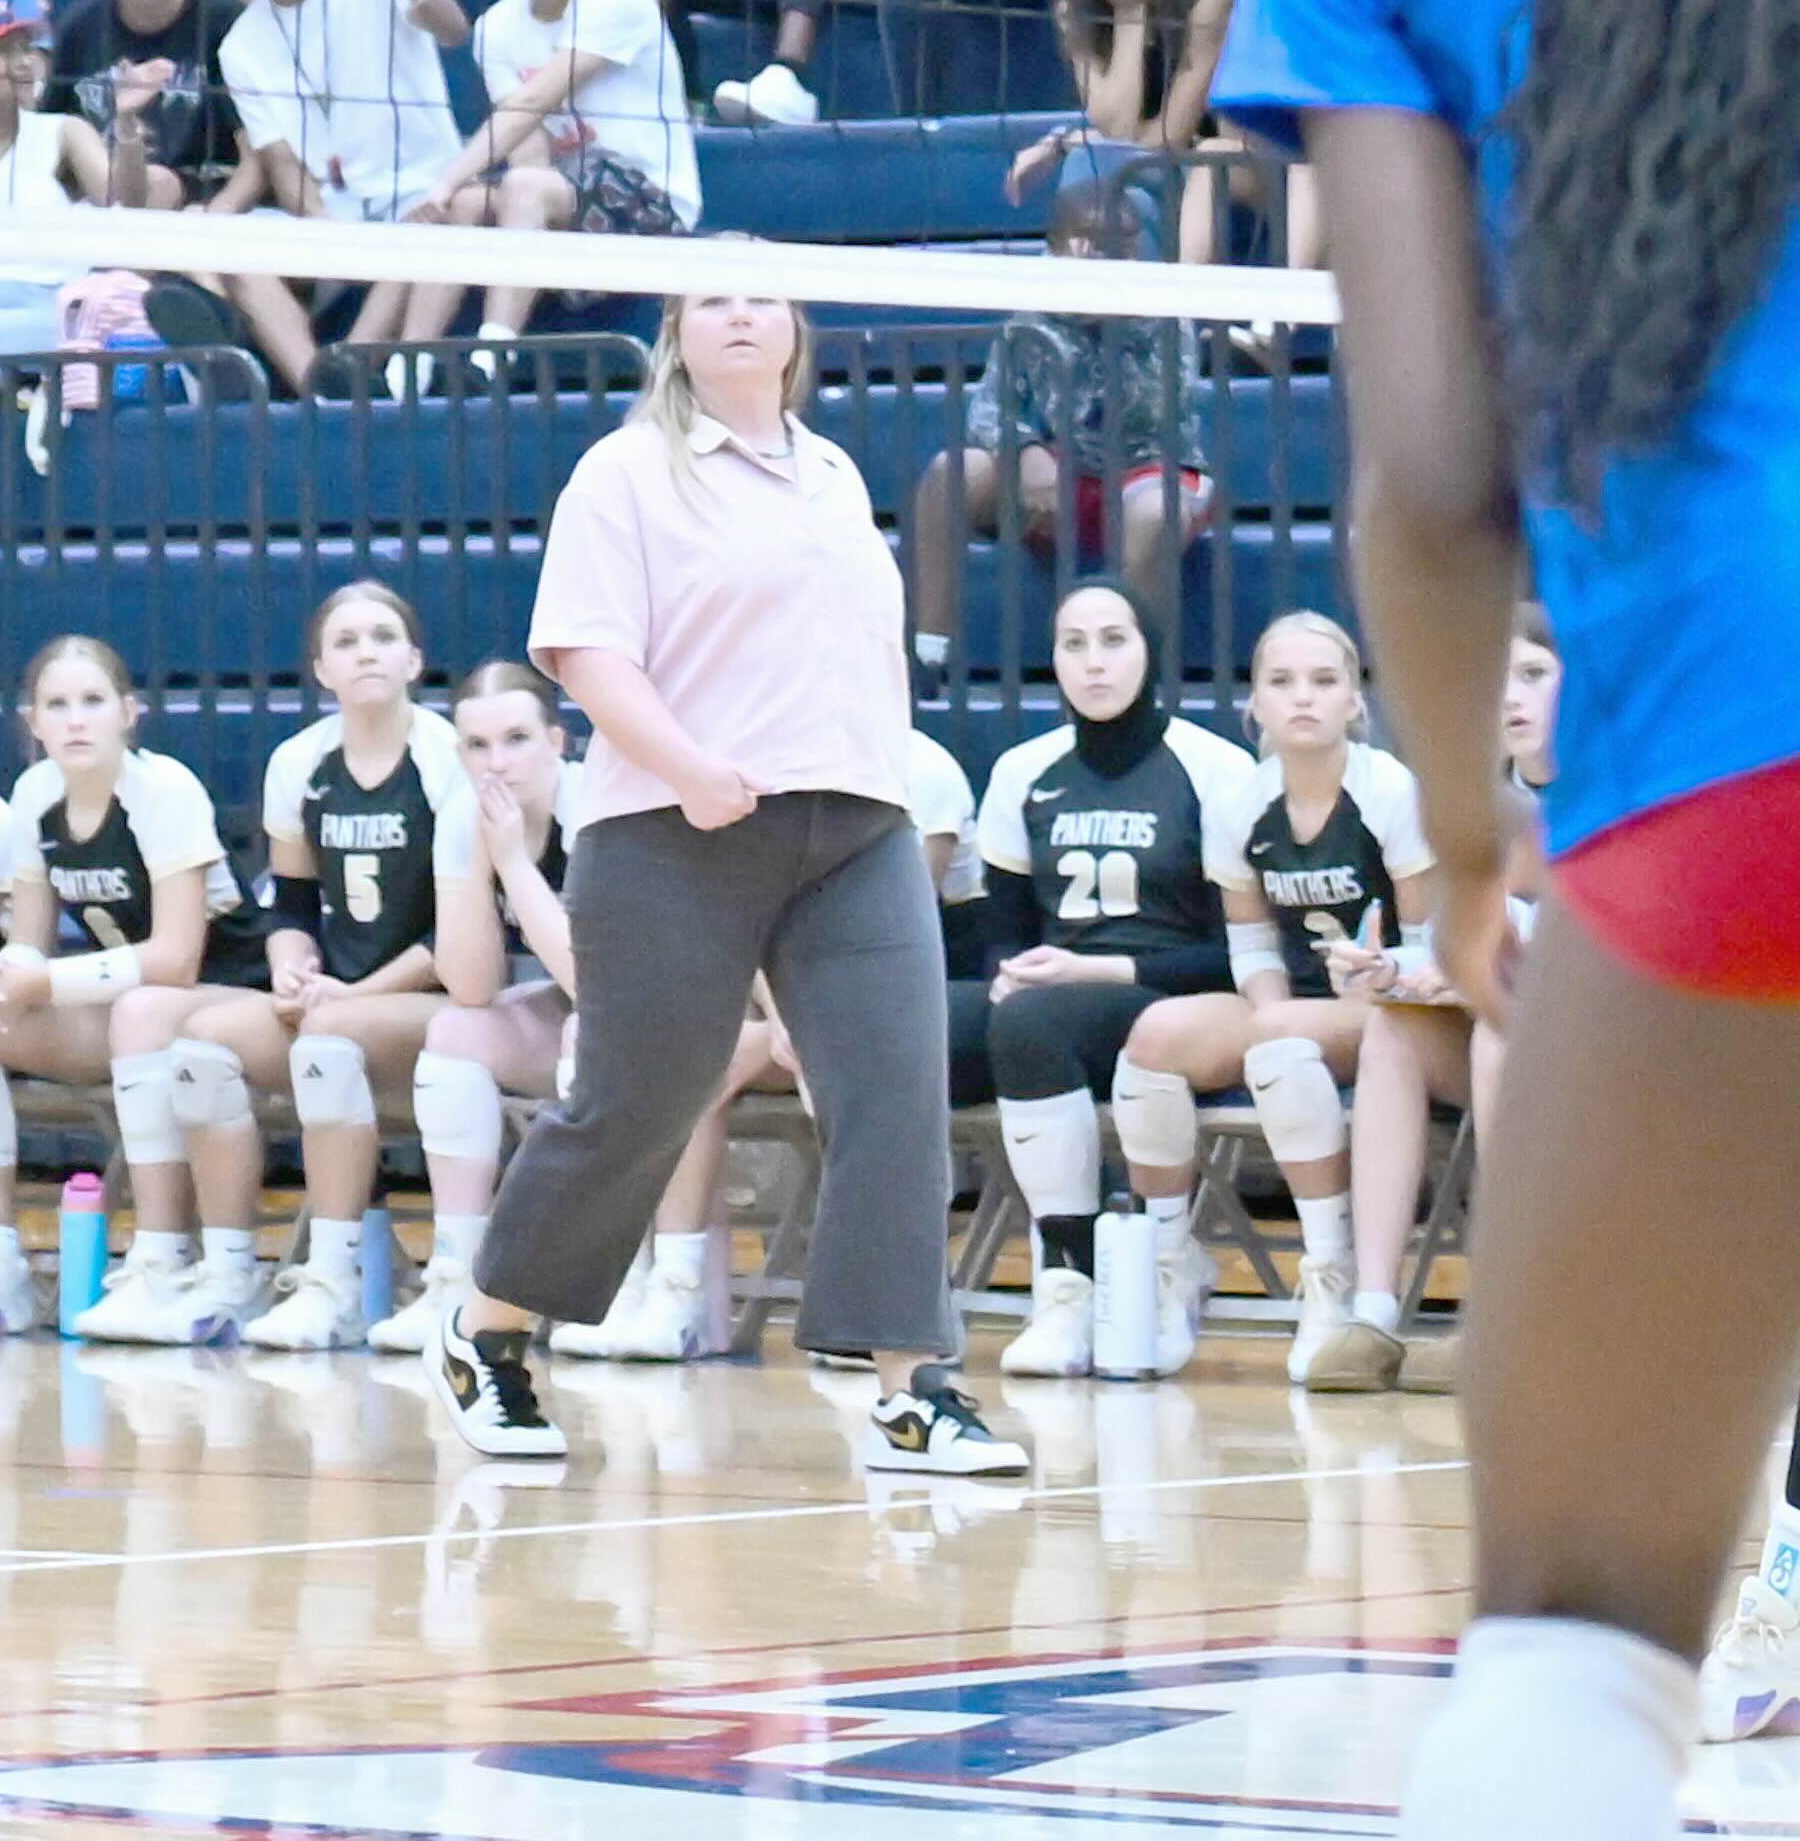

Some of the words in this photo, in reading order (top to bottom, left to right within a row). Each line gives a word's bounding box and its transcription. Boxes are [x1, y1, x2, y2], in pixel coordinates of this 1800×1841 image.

[1051, 810, 1157, 848] PANTHERS
[344, 854, 382, 922] 5
[1263, 866, 1364, 906] PANTHERS
